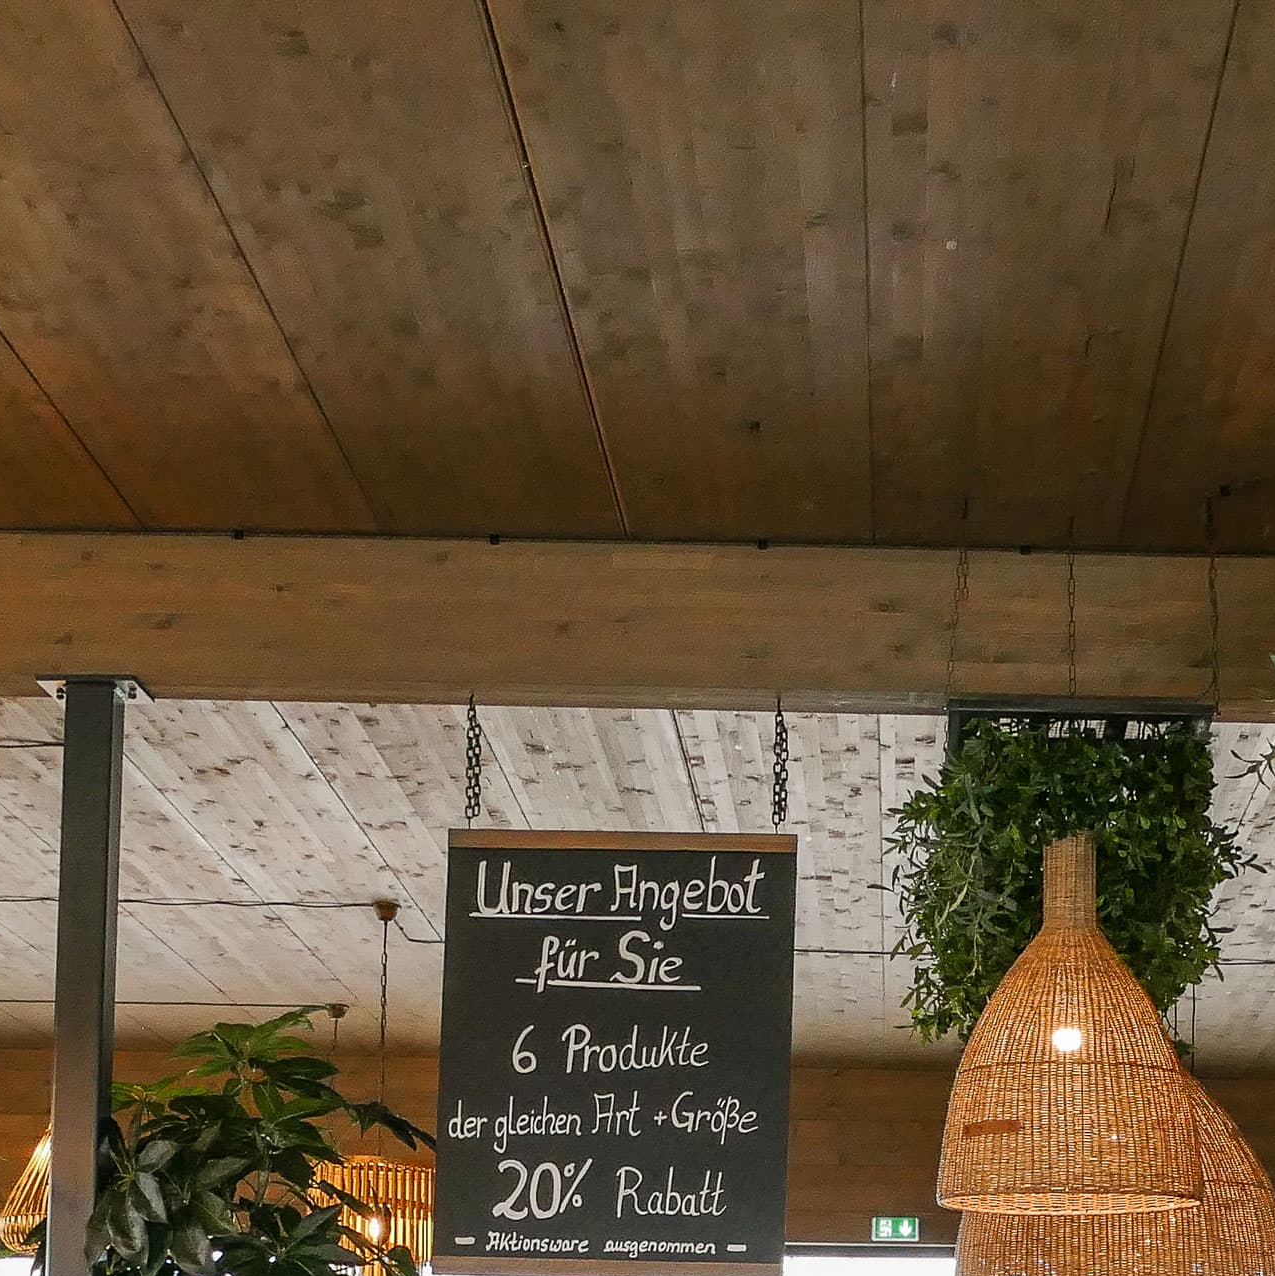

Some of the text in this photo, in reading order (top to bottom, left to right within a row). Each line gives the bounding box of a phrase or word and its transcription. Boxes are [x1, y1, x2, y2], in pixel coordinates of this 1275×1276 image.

[474, 855, 766, 931] Unser Angebot
[533, 929, 685, 994] für Sie
[511, 1022, 710, 1074] 6 Produkte
[447, 1099, 489, 1140] der
[494, 1095, 583, 1154] gleichen
[591, 1089, 643, 1138] Art
[491, 1158, 728, 1221] 20% Rabatt
[603, 1238, 717, 1259] ausgenommen
